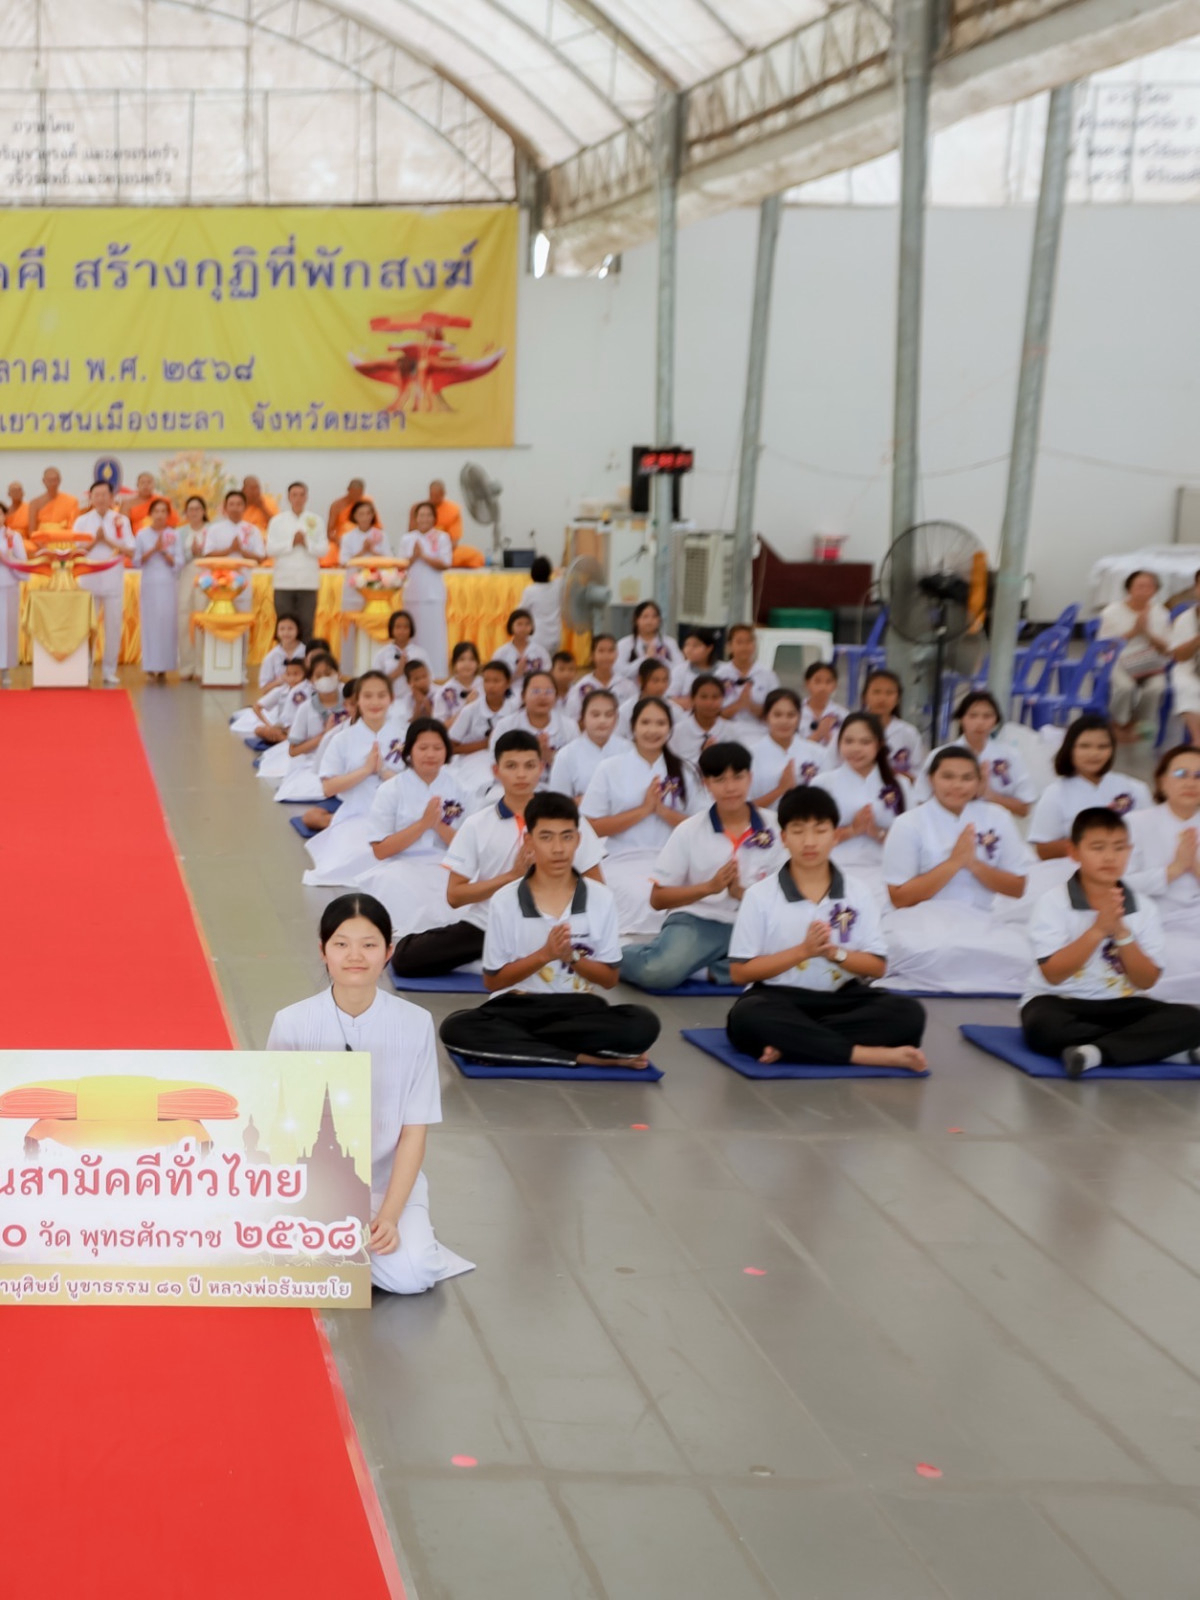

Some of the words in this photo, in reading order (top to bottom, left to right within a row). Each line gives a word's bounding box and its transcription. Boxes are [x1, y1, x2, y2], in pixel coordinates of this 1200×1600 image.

[73, 234, 479, 302] สร้างกุฏิที่พักสงฆ์
[84, 354, 147, 384] พ.ศ.
[162, 354, 256, 384] ๒๕๖๘
[250, 400, 407, 433] จังหวัดยะลา
[39, 1220, 71, 1247] วัด
[81, 1220, 222, 1257] พุทธศักราช
[234, 1220, 356, 1250] ๒๕๖๘
[66, 1280, 150, 1299] บูชาธรรม
[156, 1282, 182, 1294] ๘๑
[189, 1276, 202, 1295] ปี
[208, 1277, 350, 1297] หลวงพ่อธัมมชโย
